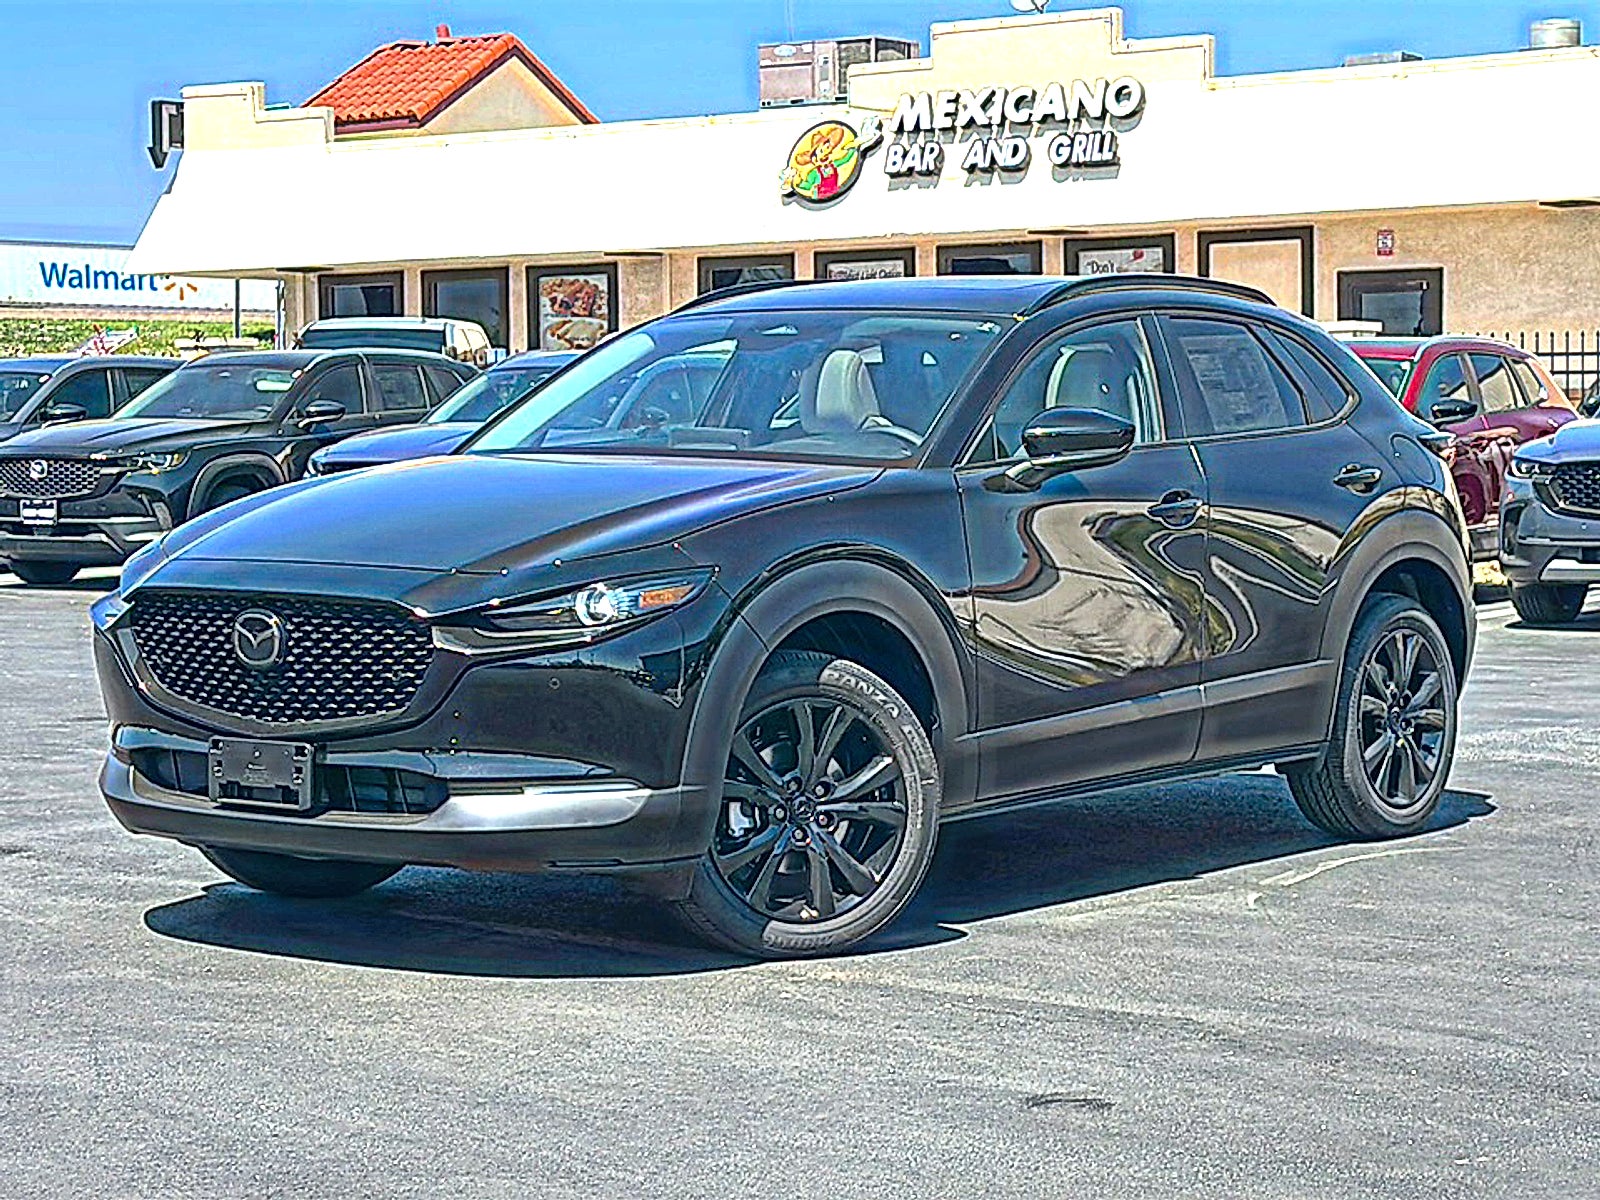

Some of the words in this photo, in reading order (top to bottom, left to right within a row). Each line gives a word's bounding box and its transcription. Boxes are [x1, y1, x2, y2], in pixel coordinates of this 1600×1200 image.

[890, 76, 1144, 133] MEXICANO
[884, 141, 942, 175] BAR
[961, 136, 1029, 169] AND
[1049, 131, 1117, 165] GRILL
[39, 261, 158, 291] Walmart
